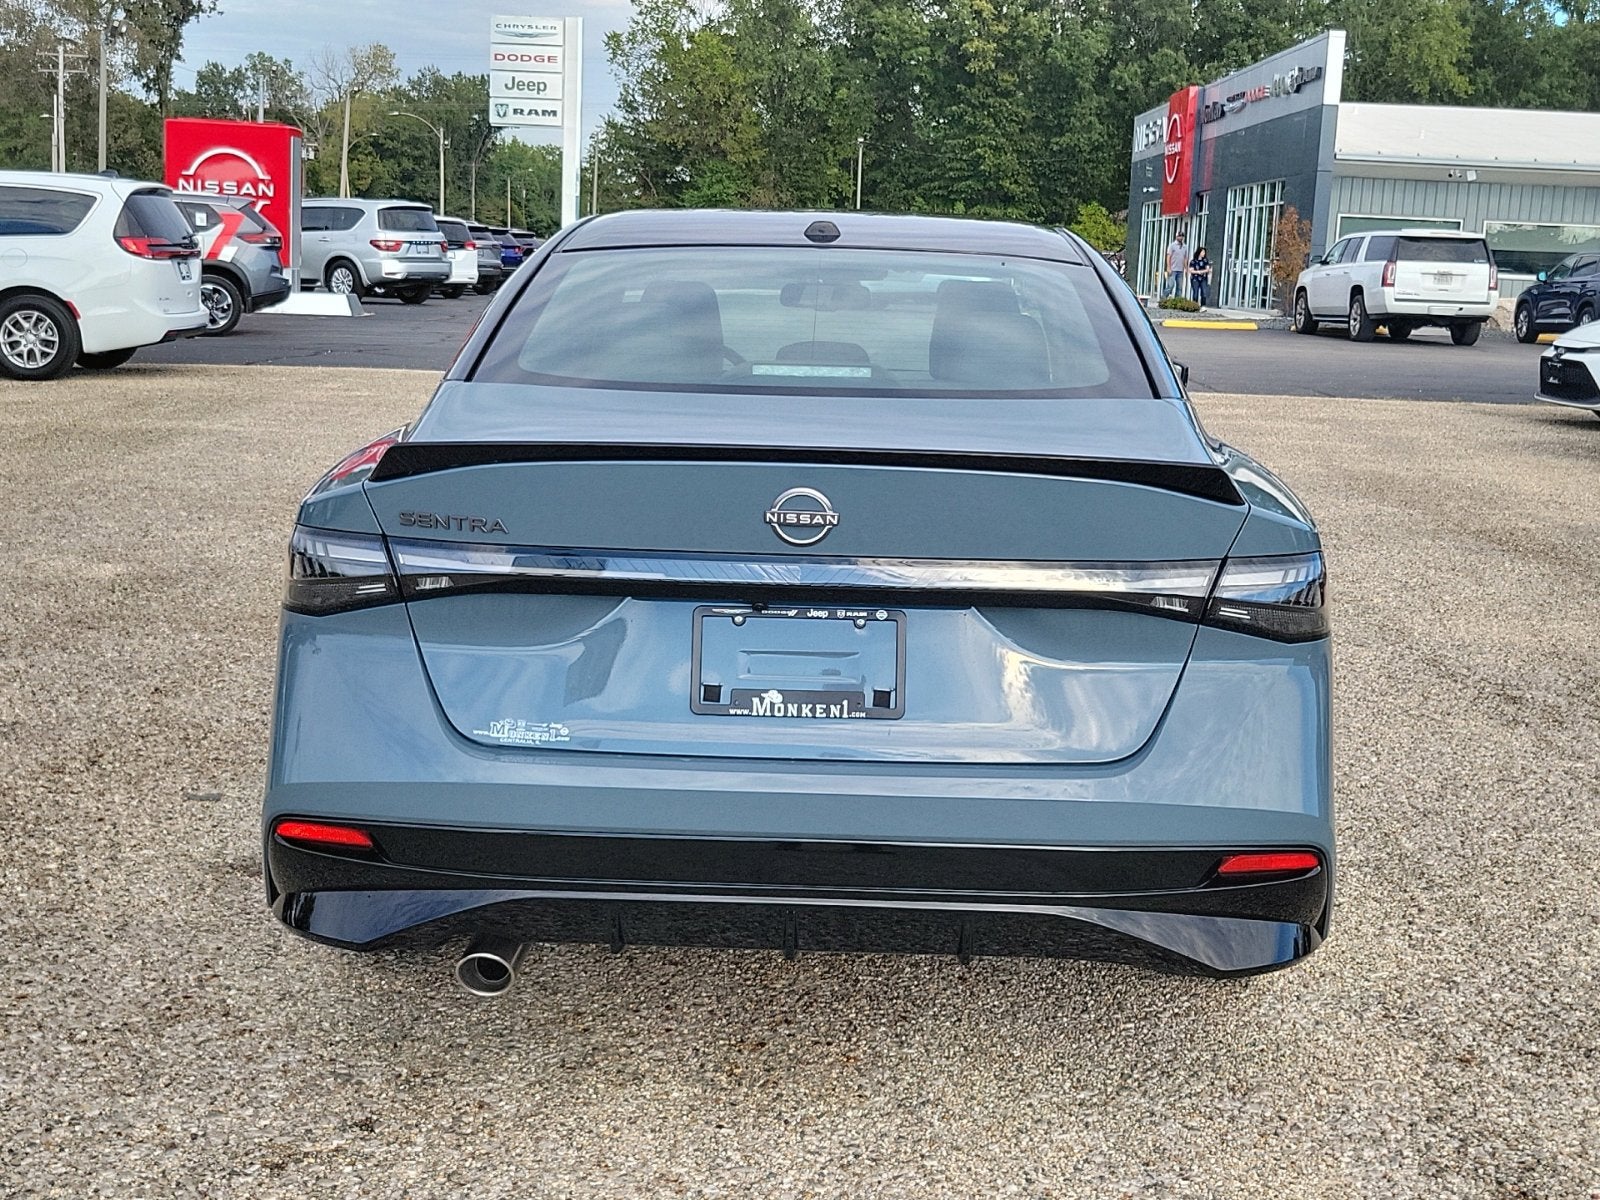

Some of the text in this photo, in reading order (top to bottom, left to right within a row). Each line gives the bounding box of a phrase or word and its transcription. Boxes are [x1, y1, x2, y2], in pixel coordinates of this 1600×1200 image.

[495, 23, 558, 31] CHRYSLER
[493, 53, 558, 63] DODGE
[504, 76, 547, 94] Jeep
[512, 108, 558, 118] RAM
[178, 178, 274, 197] NISSAN
[399, 511, 509, 534] SENTRA
[766, 512, 838, 525] NISSAN
[807, 608, 829, 618] Jeep
